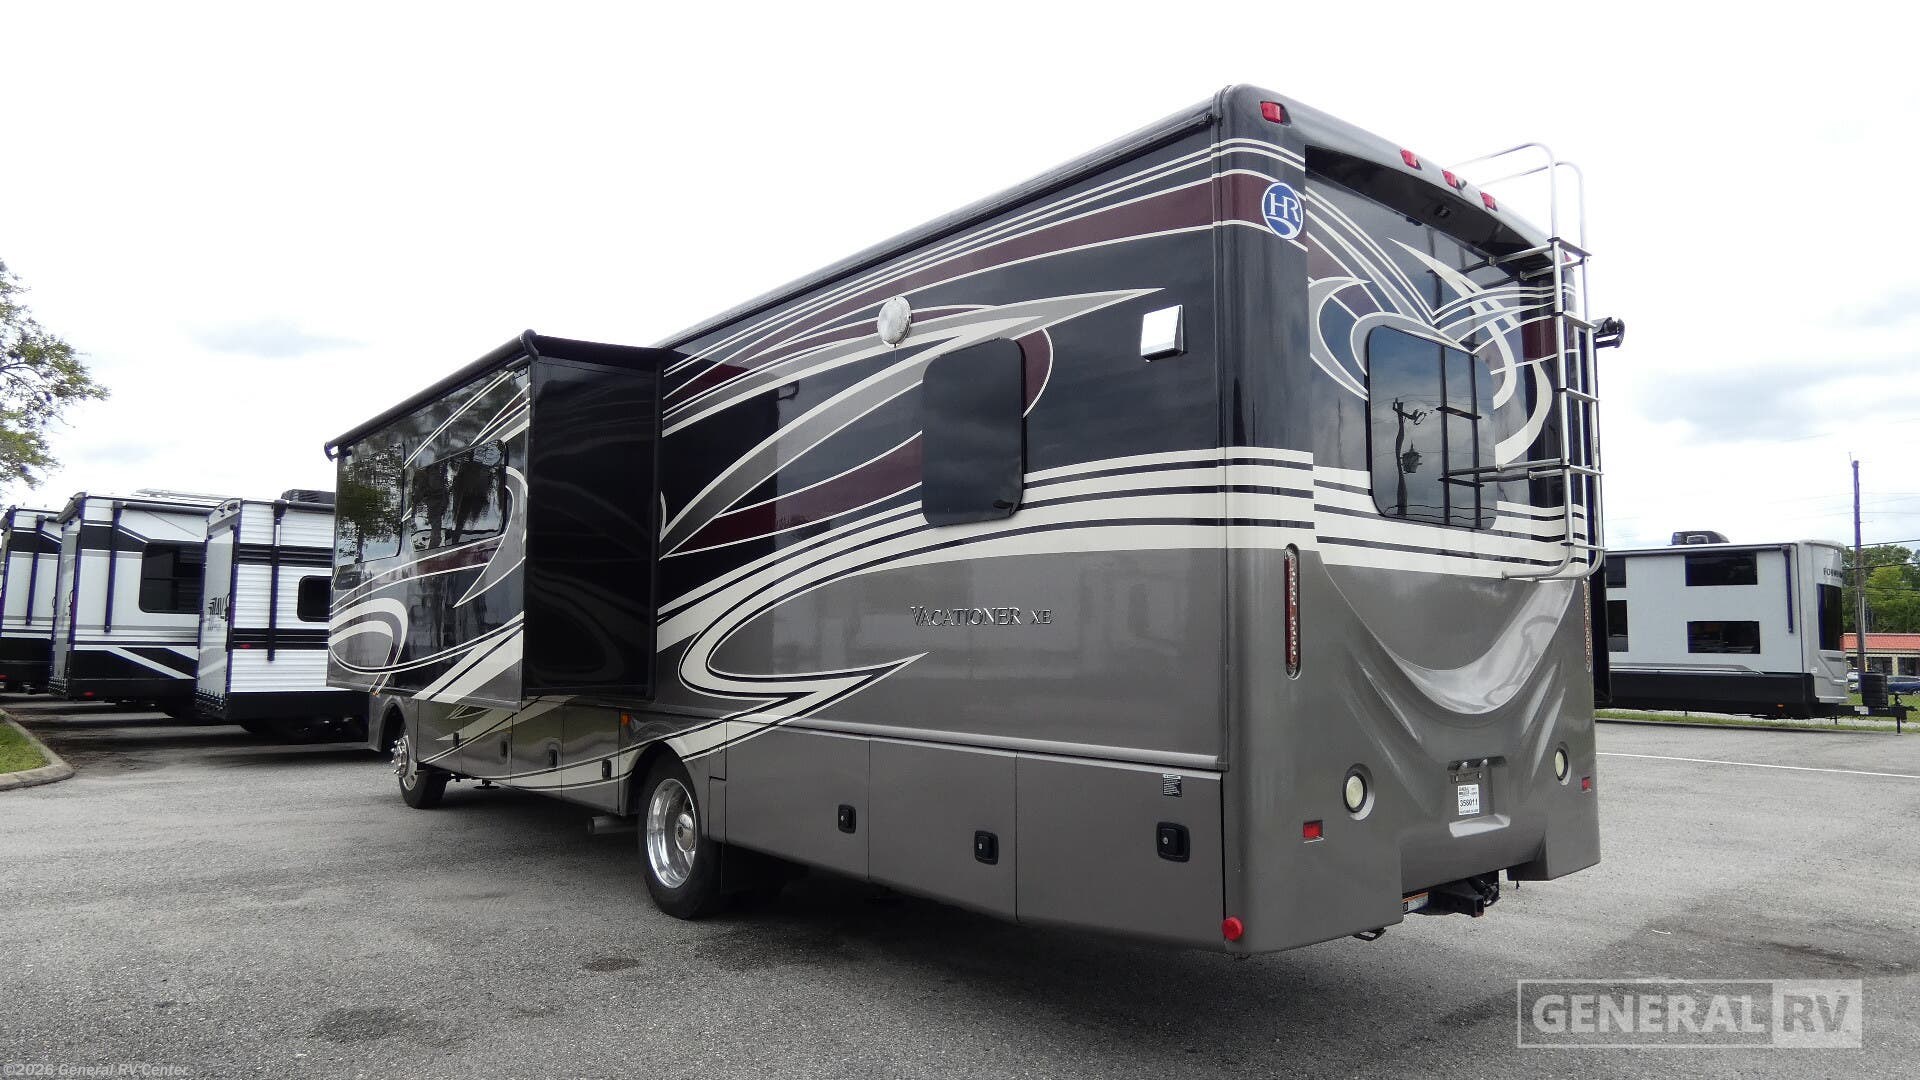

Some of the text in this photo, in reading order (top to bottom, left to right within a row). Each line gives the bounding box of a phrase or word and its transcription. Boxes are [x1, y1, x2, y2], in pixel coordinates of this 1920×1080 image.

[1268, 192, 1300, 223] HR
[910, 606, 1052, 626] VACATIONER XE
